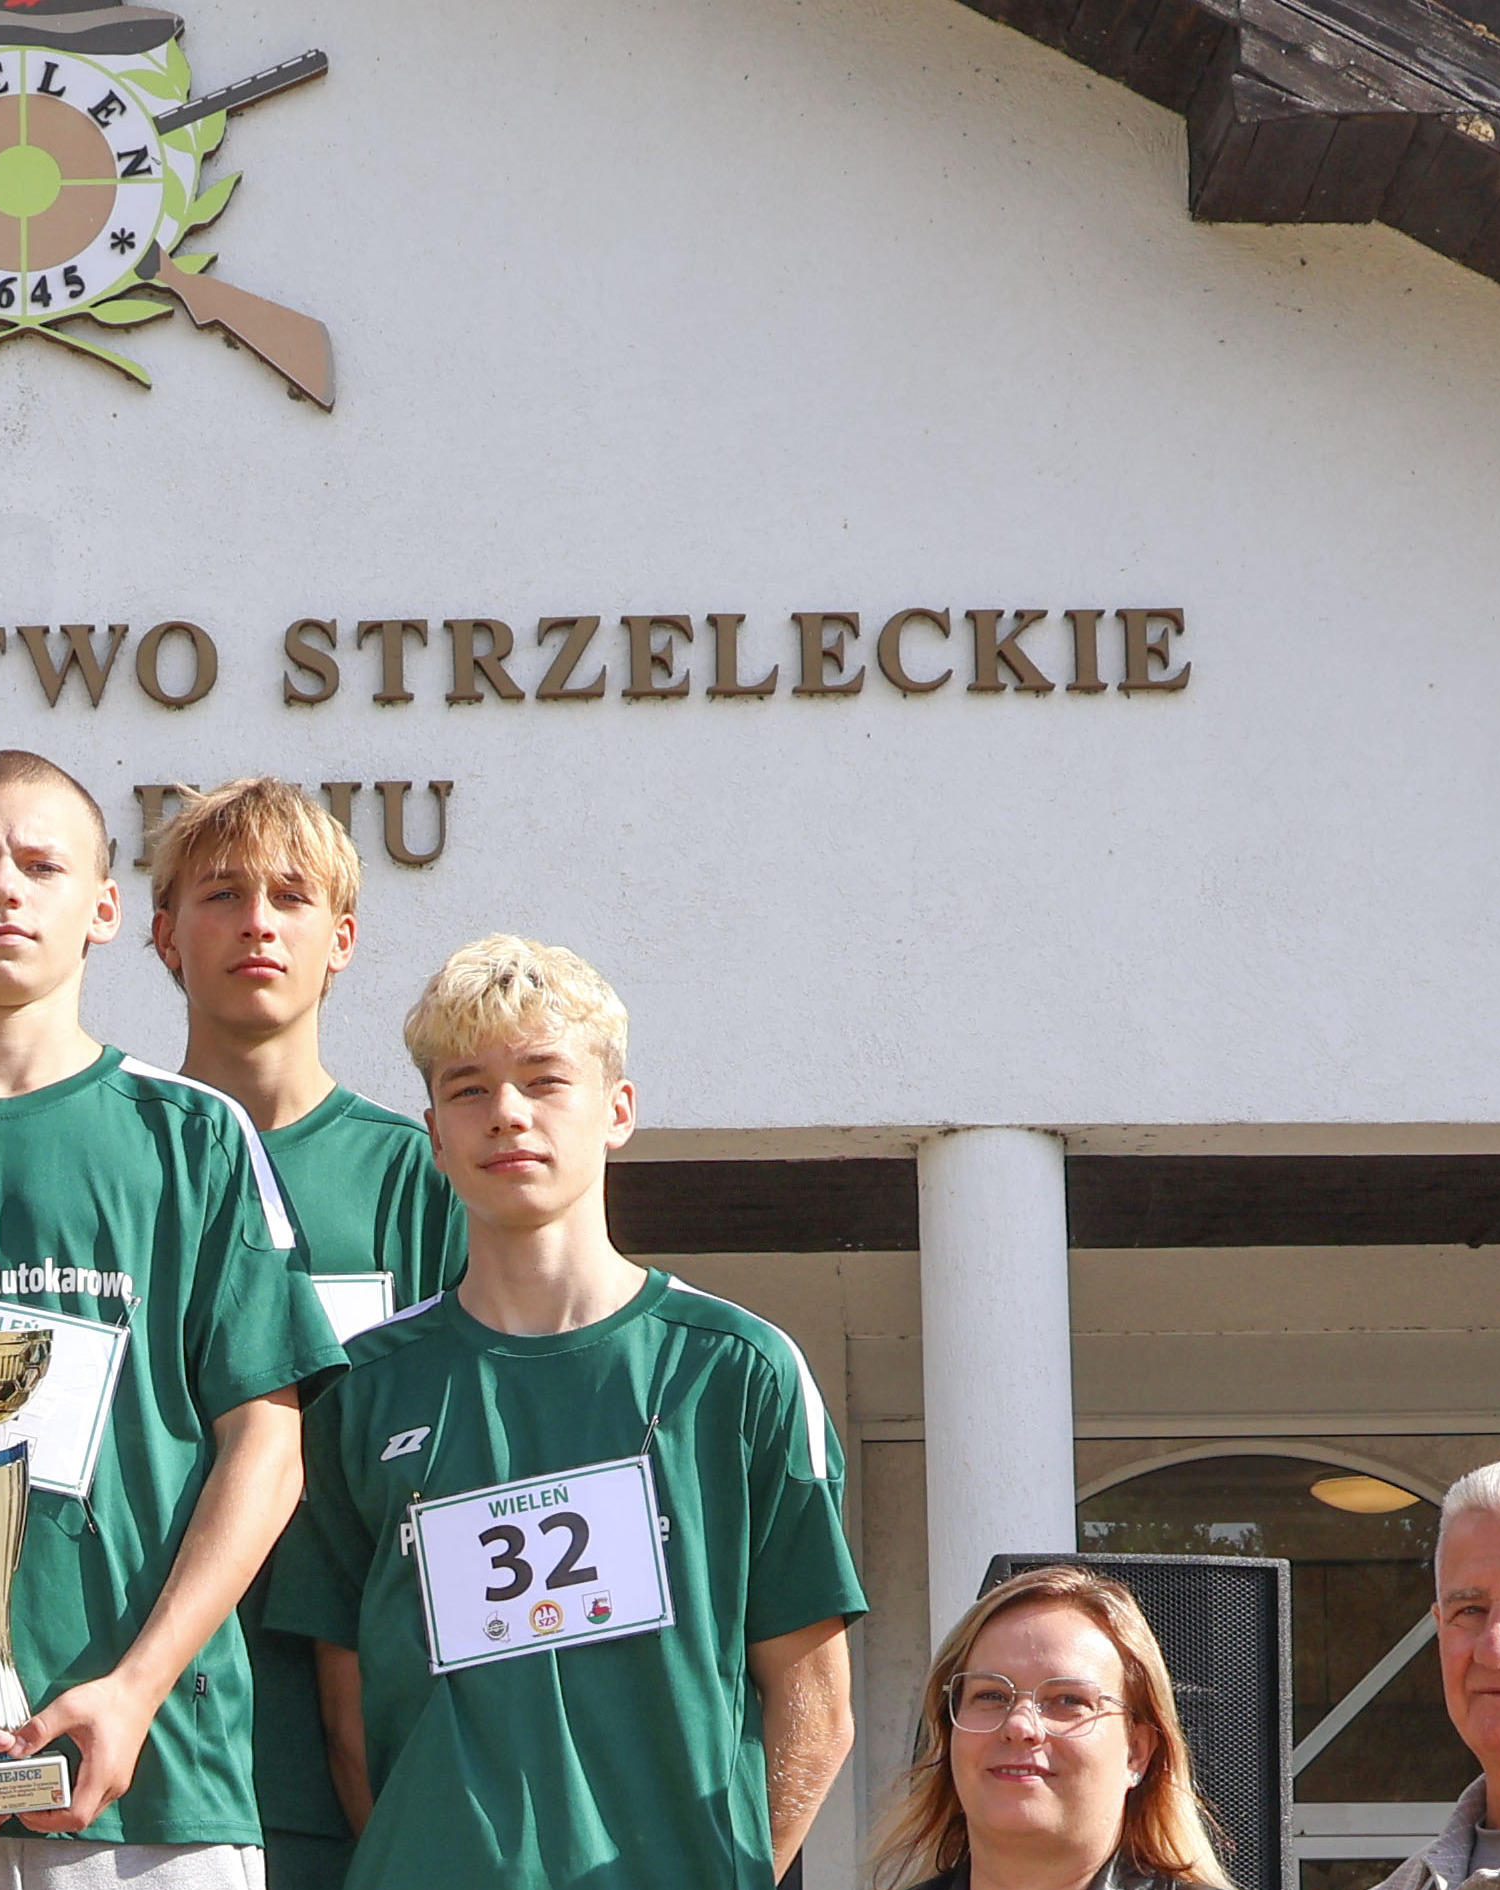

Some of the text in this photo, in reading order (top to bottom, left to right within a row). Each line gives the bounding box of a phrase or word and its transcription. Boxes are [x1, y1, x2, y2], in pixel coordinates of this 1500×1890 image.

[281, 606, 1193, 706] STRZELECKIE
[488, 1484, 569, 1518] WIELEŃ
[478, 1511, 598, 1602] 32
